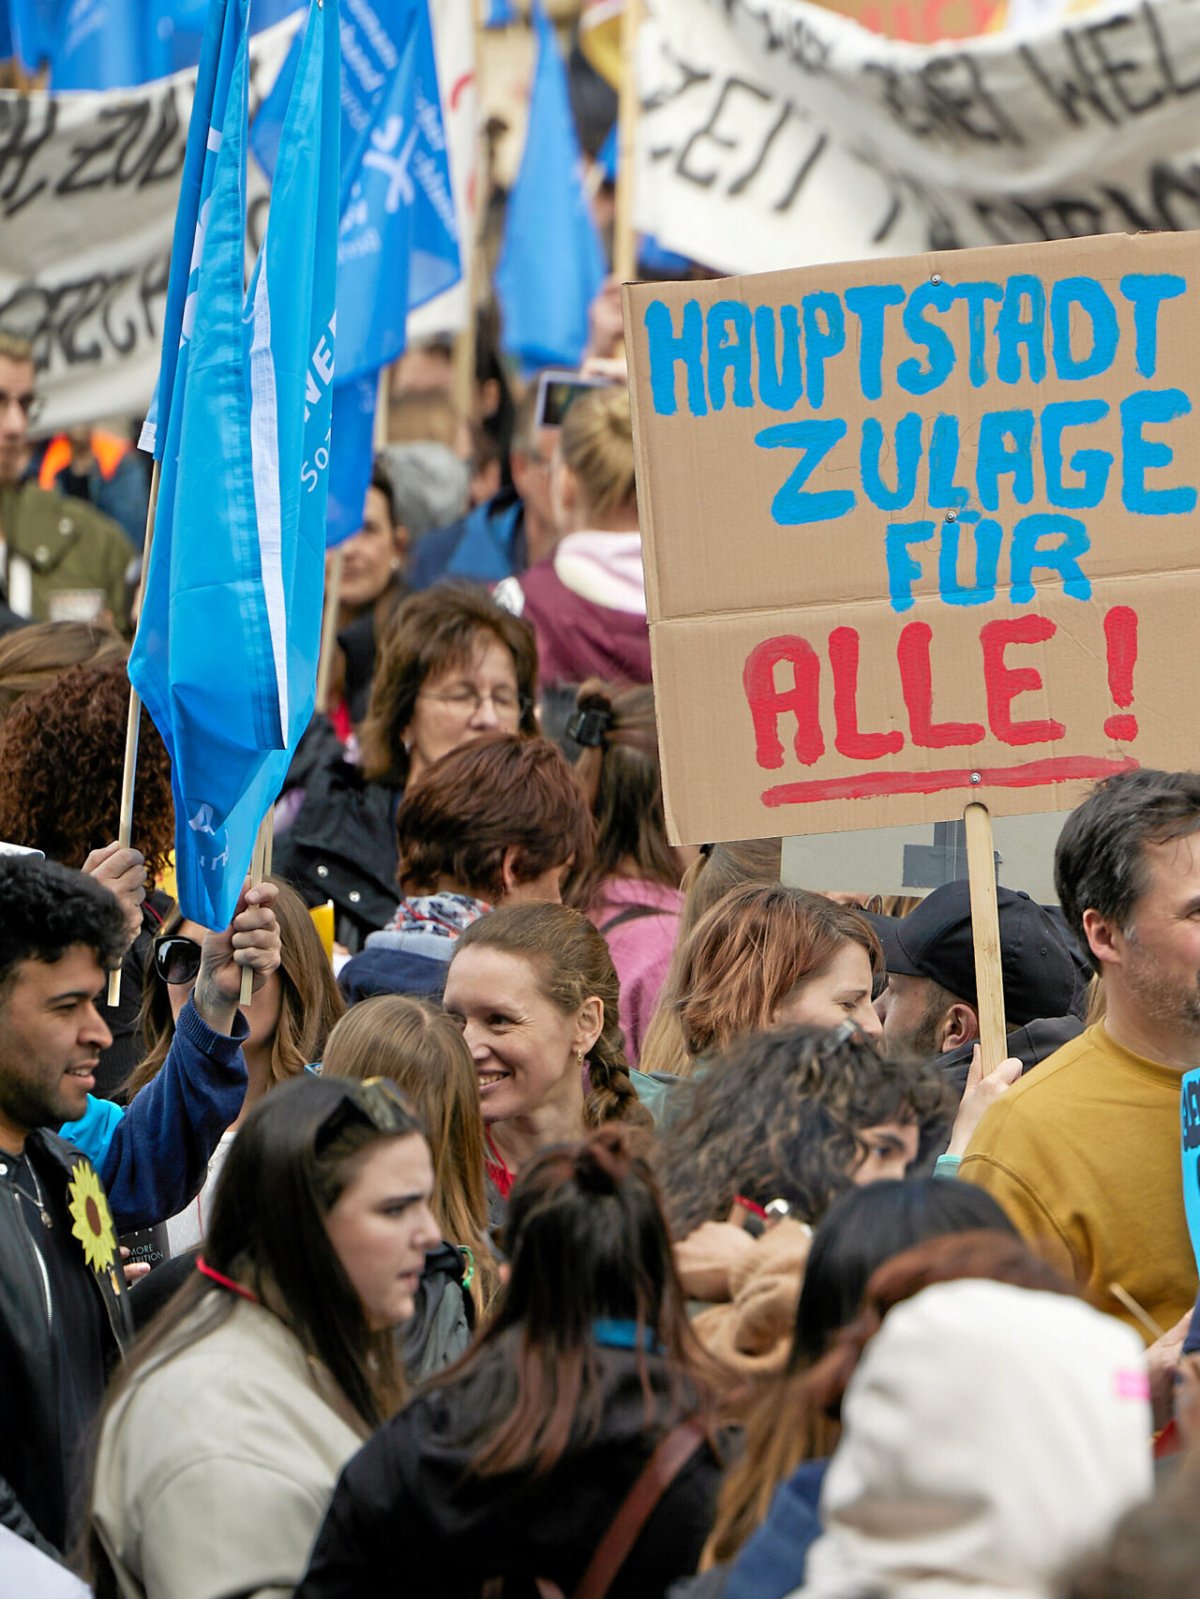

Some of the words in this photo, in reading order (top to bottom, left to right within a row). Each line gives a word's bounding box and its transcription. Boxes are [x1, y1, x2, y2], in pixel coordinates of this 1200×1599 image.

[644, 273, 1188, 417] HAUPTSTADT
[754, 388, 1198, 525] ZULAGE
[886, 508, 1093, 613] FÜR
